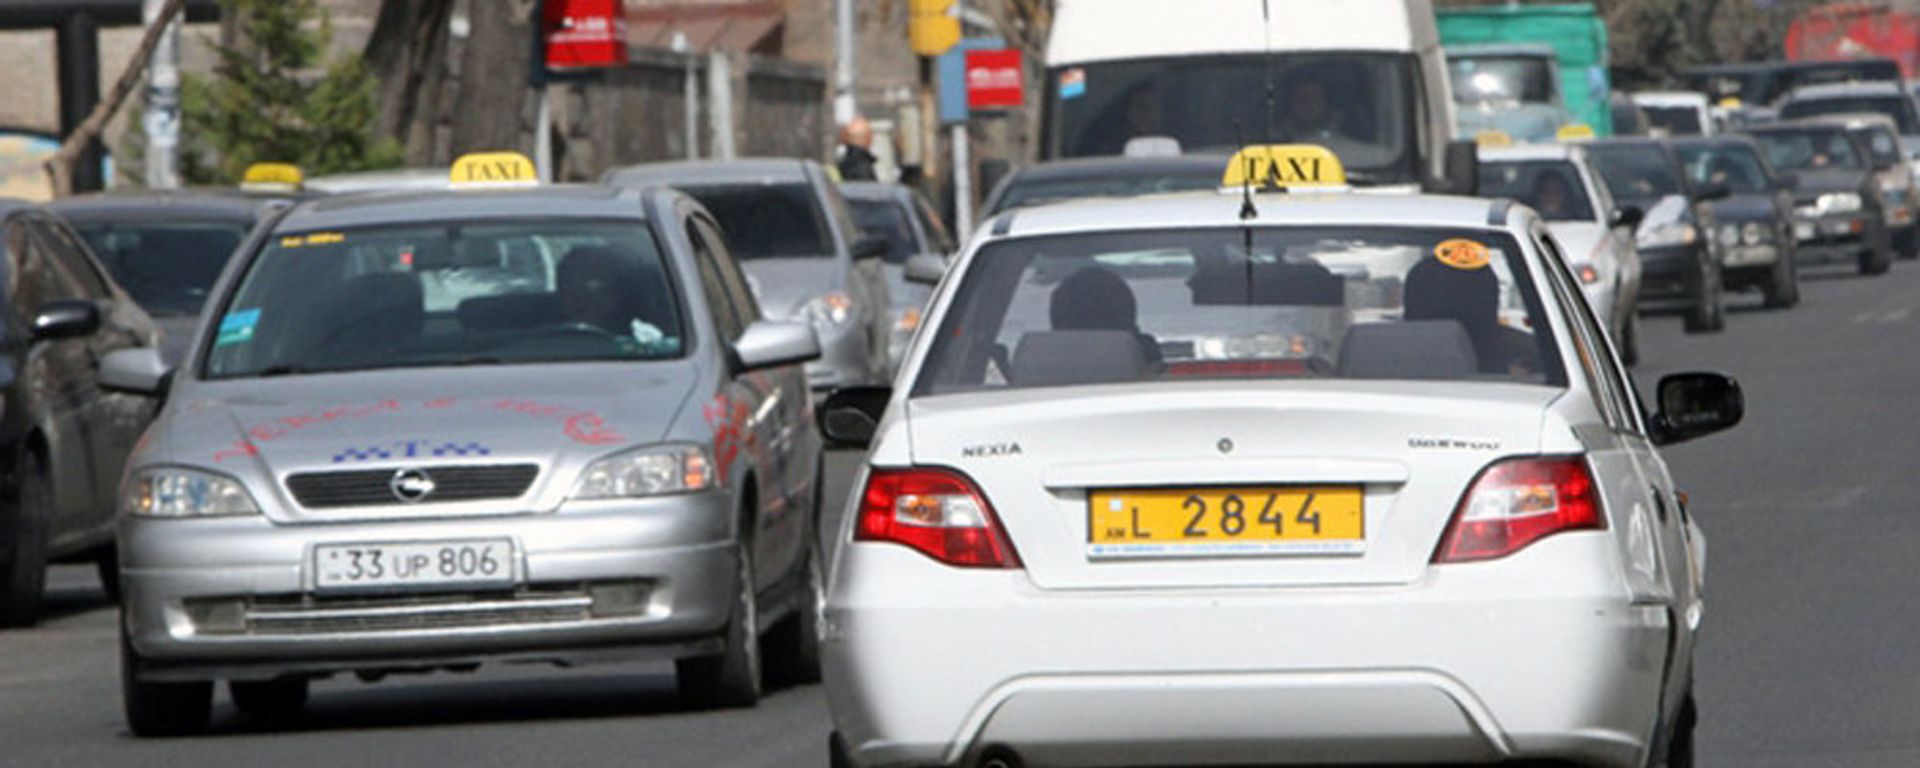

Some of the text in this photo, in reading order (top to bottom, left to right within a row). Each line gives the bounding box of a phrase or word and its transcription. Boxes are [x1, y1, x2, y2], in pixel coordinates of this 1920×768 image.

[465, 160, 520, 181] TAXI
[1242, 156, 1320, 182] TAXI
[962, 442, 1022, 457] NEXIA
[1131, 507, 1151, 538] L
[1182, 494, 1321, 536] 2844
[346, 546, 498, 580] 33 UP 806
